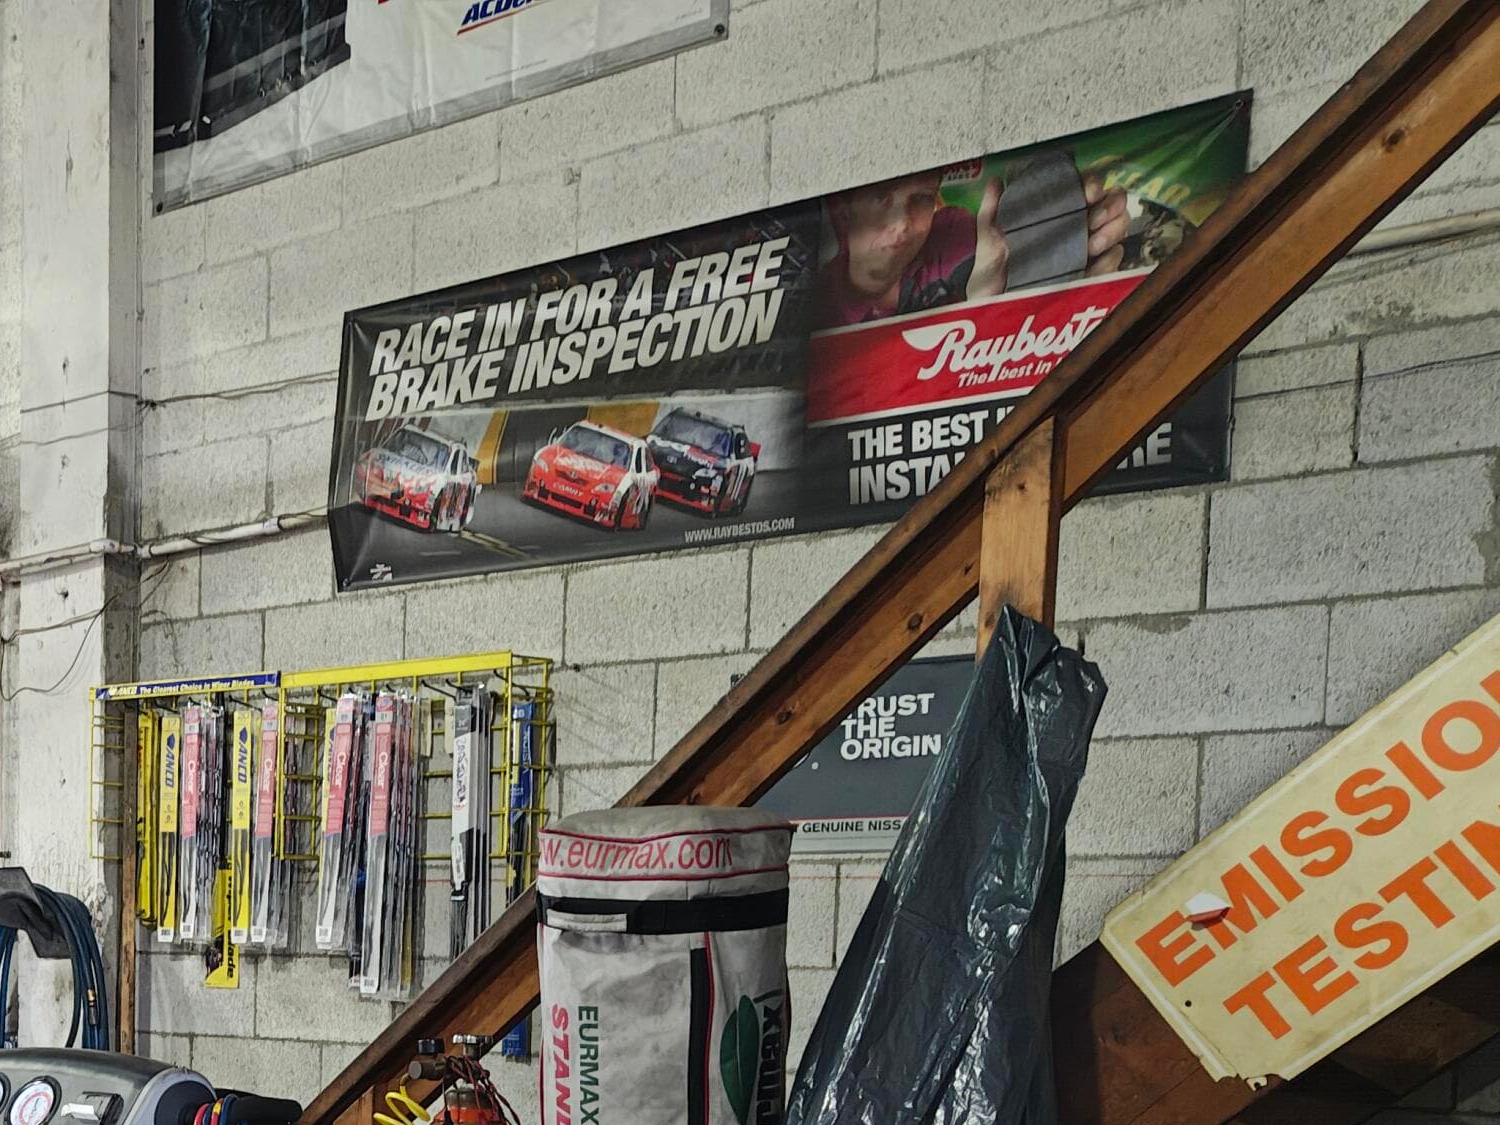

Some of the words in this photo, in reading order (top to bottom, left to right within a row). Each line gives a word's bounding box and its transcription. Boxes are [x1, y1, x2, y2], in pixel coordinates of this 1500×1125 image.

[369, 309, 475, 376] RACE
[477, 298, 527, 352] IN
[529, 277, 618, 344] FOR
[618, 268, 655, 321] A
[663, 236, 791, 311] FREE
[364, 345, 504, 422] BRAKE
[508, 289, 786, 394] INSPECTION
[957, 372, 986, 388] The
[1000, 363, 1032, 381] best
[847, 427, 903, 461] THE
[912, 410, 988, 453] BEST
[849, 452, 966, 505] INSTA
[684, 517, 795, 544] WWW.RAYBESTOS.COM
[847, 693, 935, 717] RUST
[840, 717, 896, 740] THE
[238, 742, 248, 784] ANCO
[840, 734, 941, 761] ORIGIN
[166, 748, 175, 788] ANCO
[335, 752, 347, 788] Clear
[378, 751, 387, 788] Clear
[802, 820, 864, 833] GENUINE
[578, 1005, 599, 1125] EURMAX
